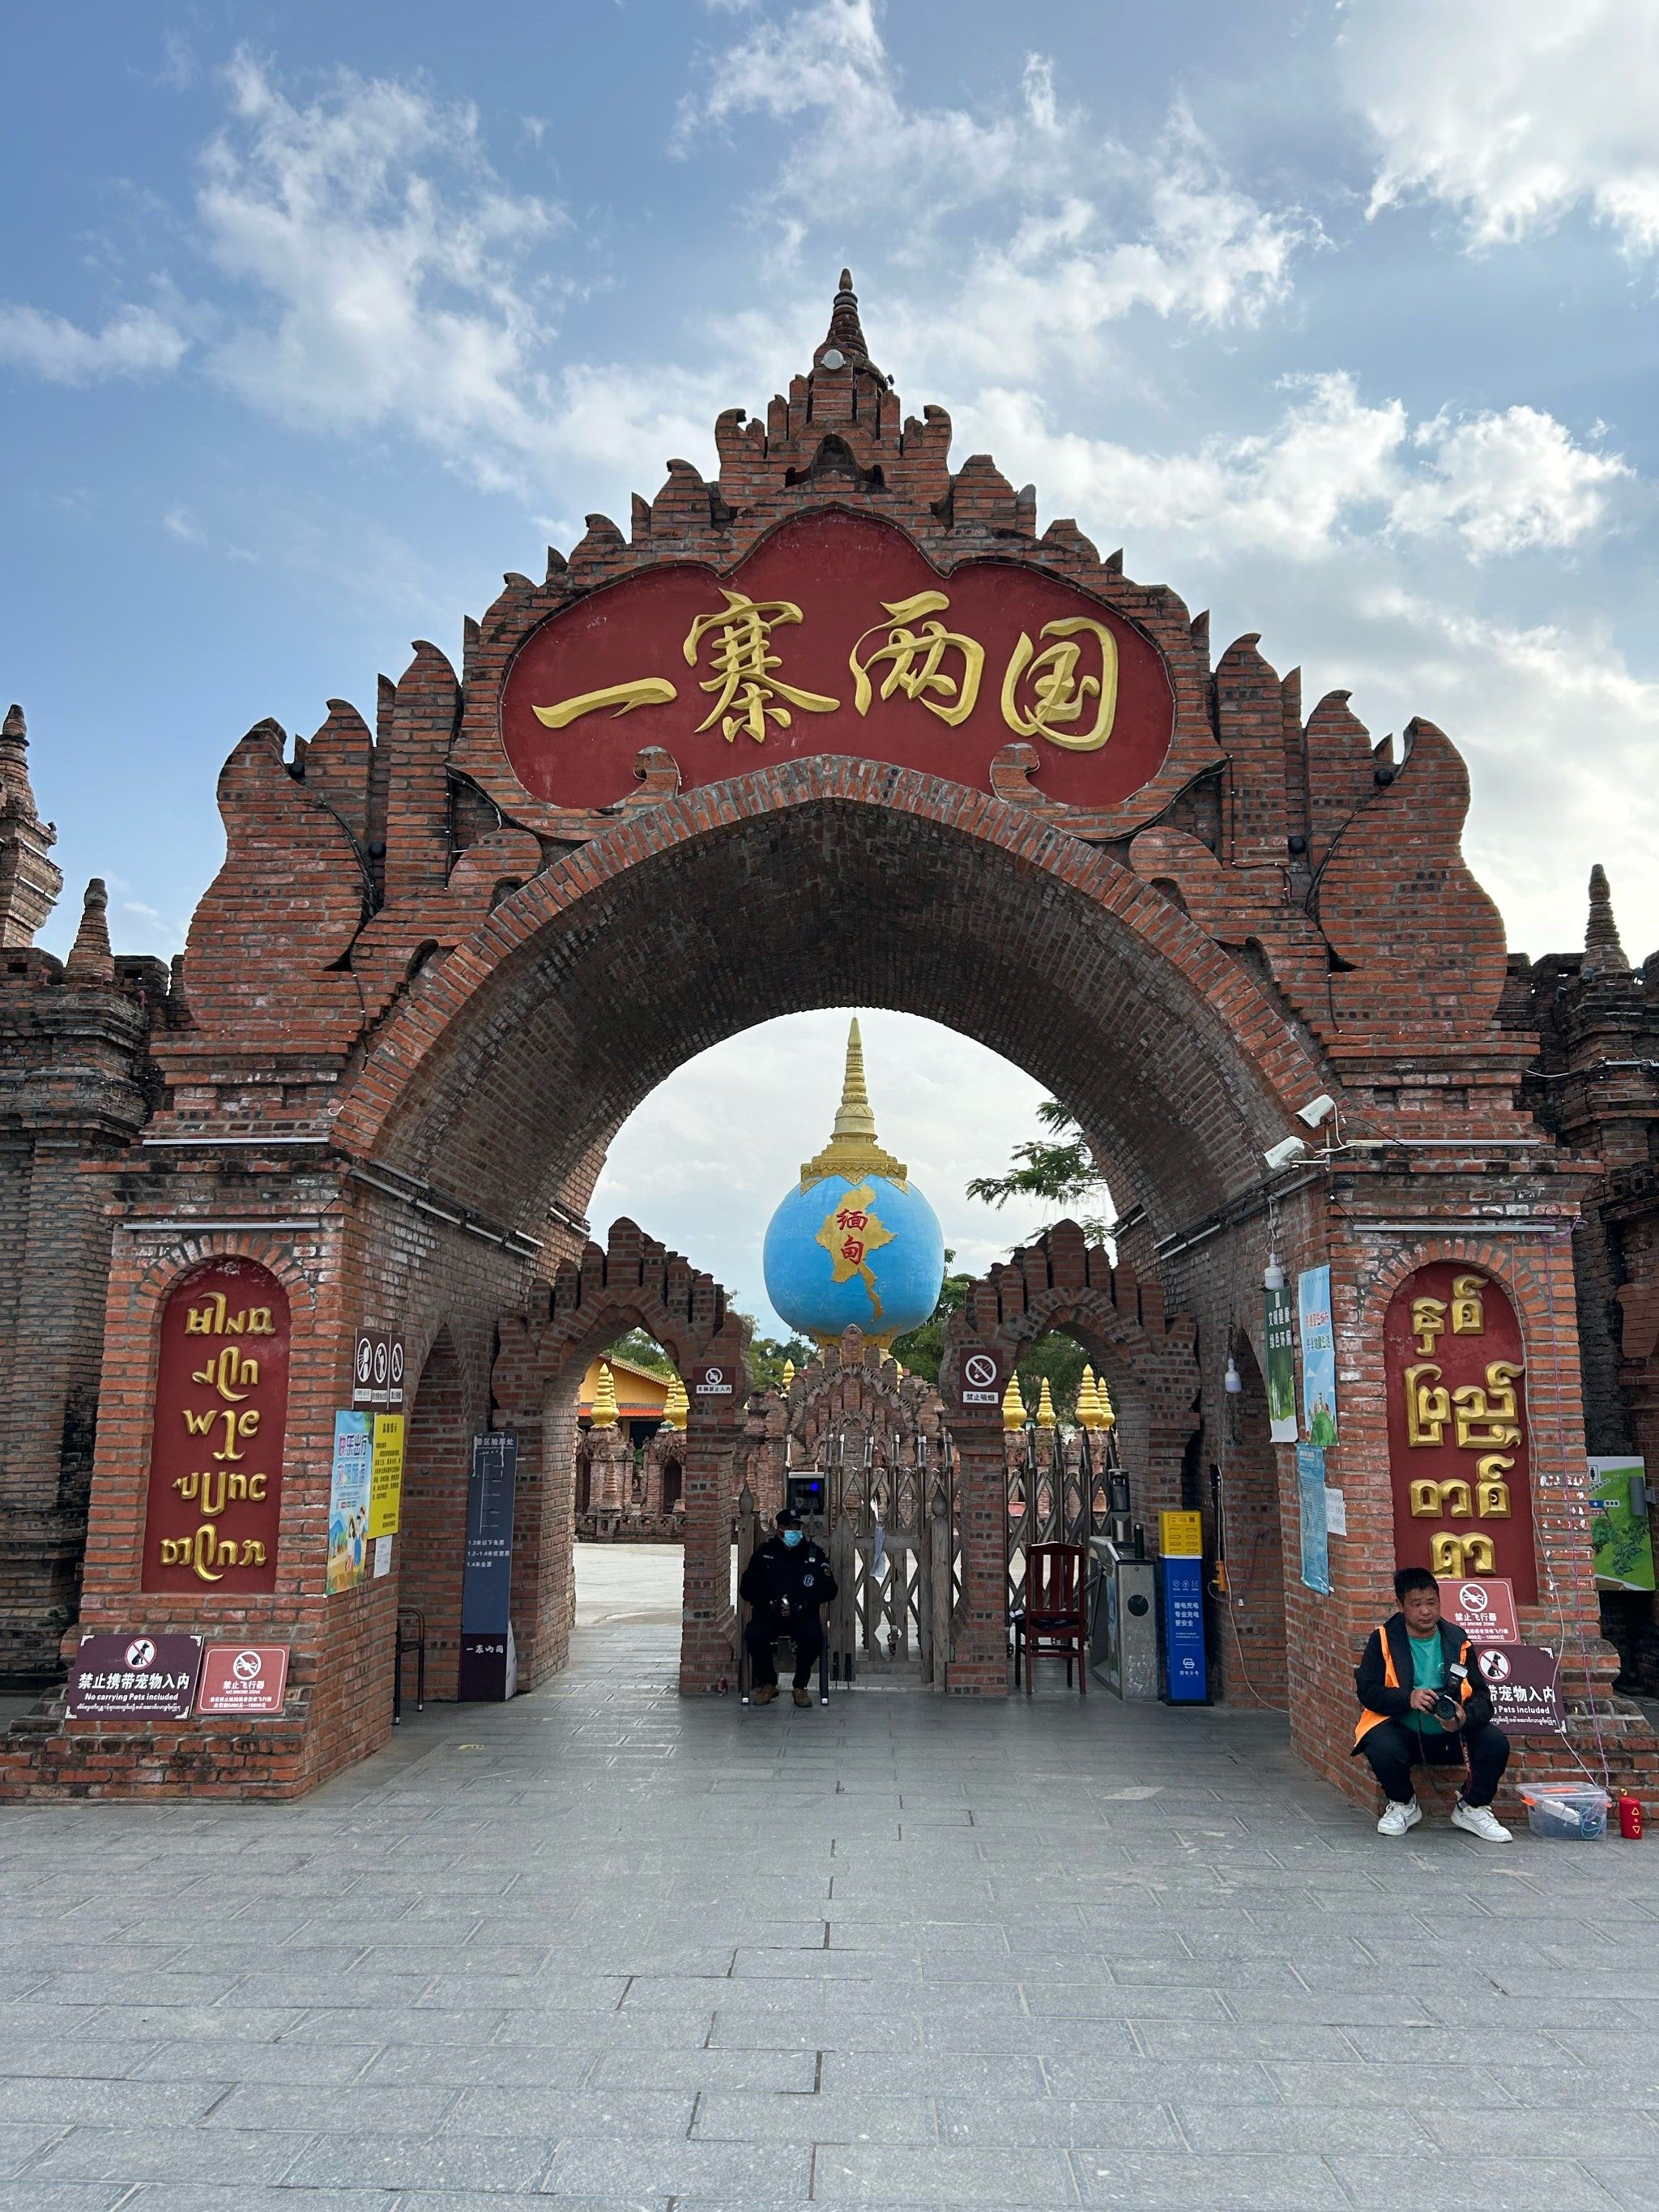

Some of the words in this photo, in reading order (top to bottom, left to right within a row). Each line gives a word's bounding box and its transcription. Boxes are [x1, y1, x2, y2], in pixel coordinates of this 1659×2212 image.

[531, 587, 1120, 752] 一寨两国
[836, 1208, 869, 1266] 缅甸
[966, 1393, 995, 1402] 禁止吸烟
[339, 1434, 369, 1456] 快乐出行
[1454, 1612, 1496, 1622] 禁止飞行器
[78, 1672, 190, 1689] 禁止携带宠物入内
[223, 1680, 265, 1689] 禁止飞行器
[85, 1693, 96, 1701] No
[97, 1693, 128, 1702] carrying
[130, 1693, 145, 1701] Pets
[147, 1693, 179, 1701] included
[1498, 1705, 1516, 1713] Pets
[1516, 1706, 1550, 1715] included
